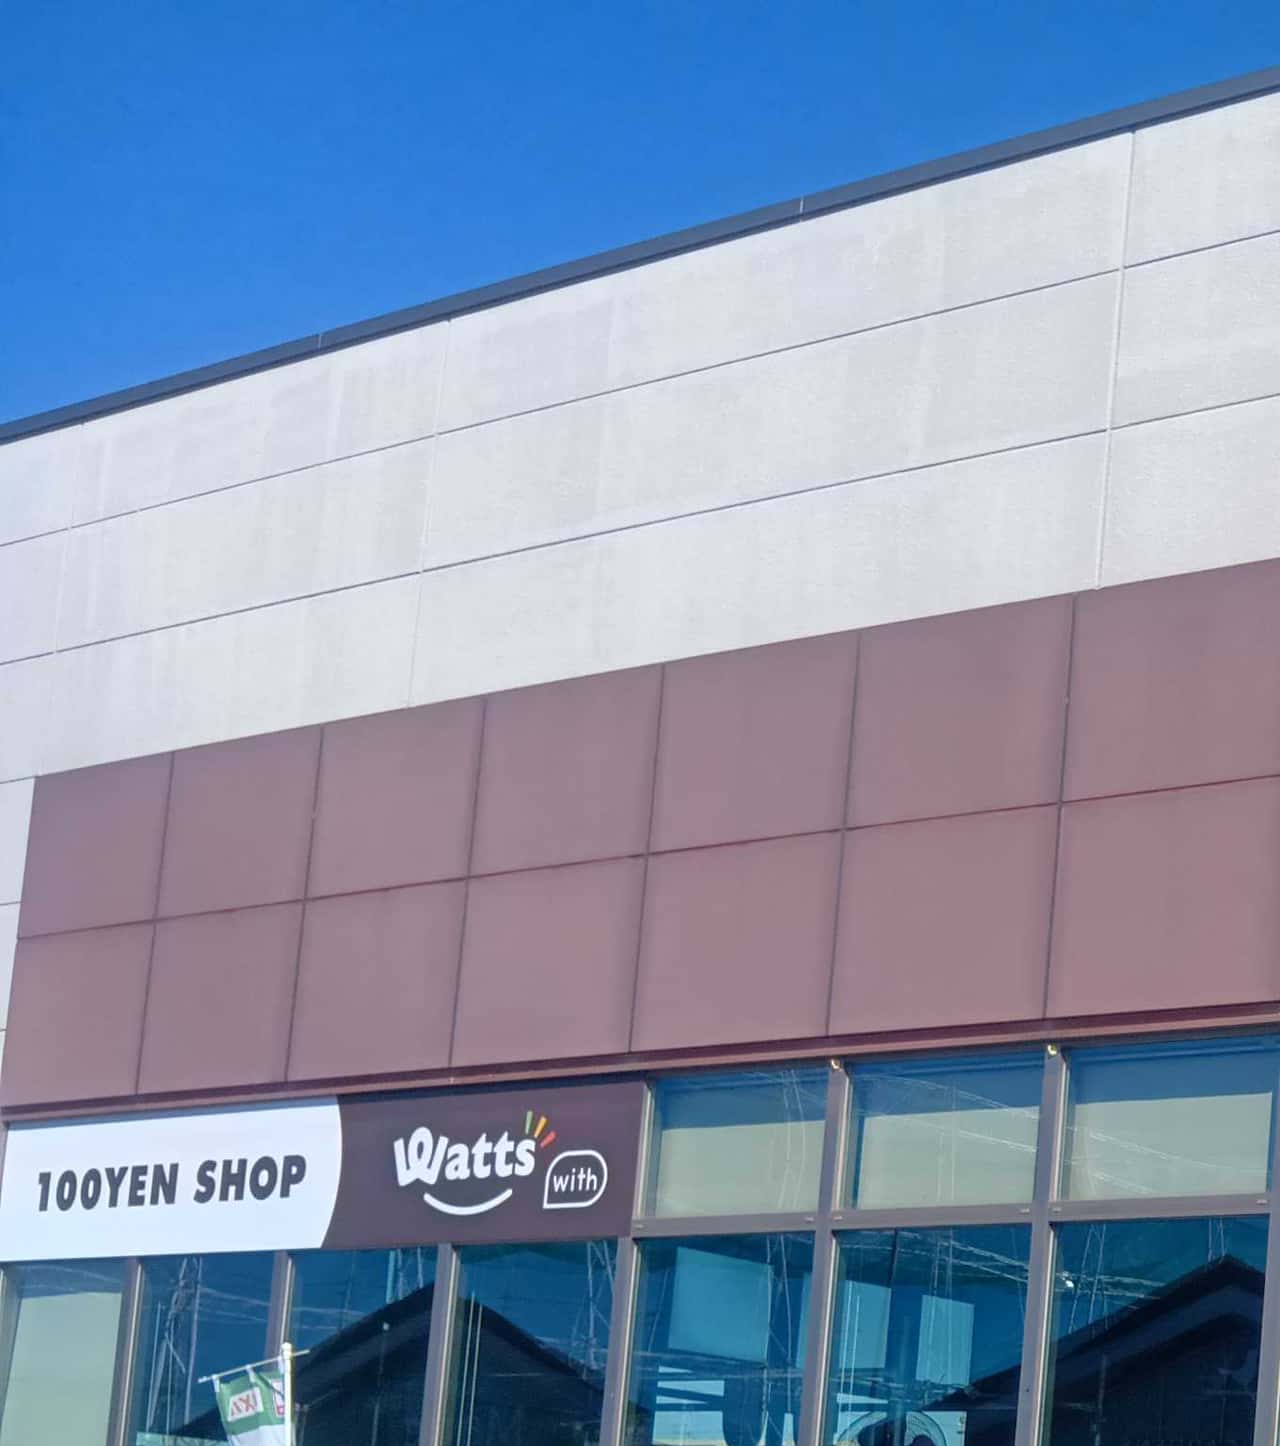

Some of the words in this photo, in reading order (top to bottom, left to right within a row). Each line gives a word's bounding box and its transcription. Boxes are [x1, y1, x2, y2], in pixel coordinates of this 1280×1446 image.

[37, 1163, 179, 1212] 100YEN
[193, 1155, 307, 1202] SHOP
[393, 1126, 536, 1188] Watts
[551, 1166, 598, 1193] with
